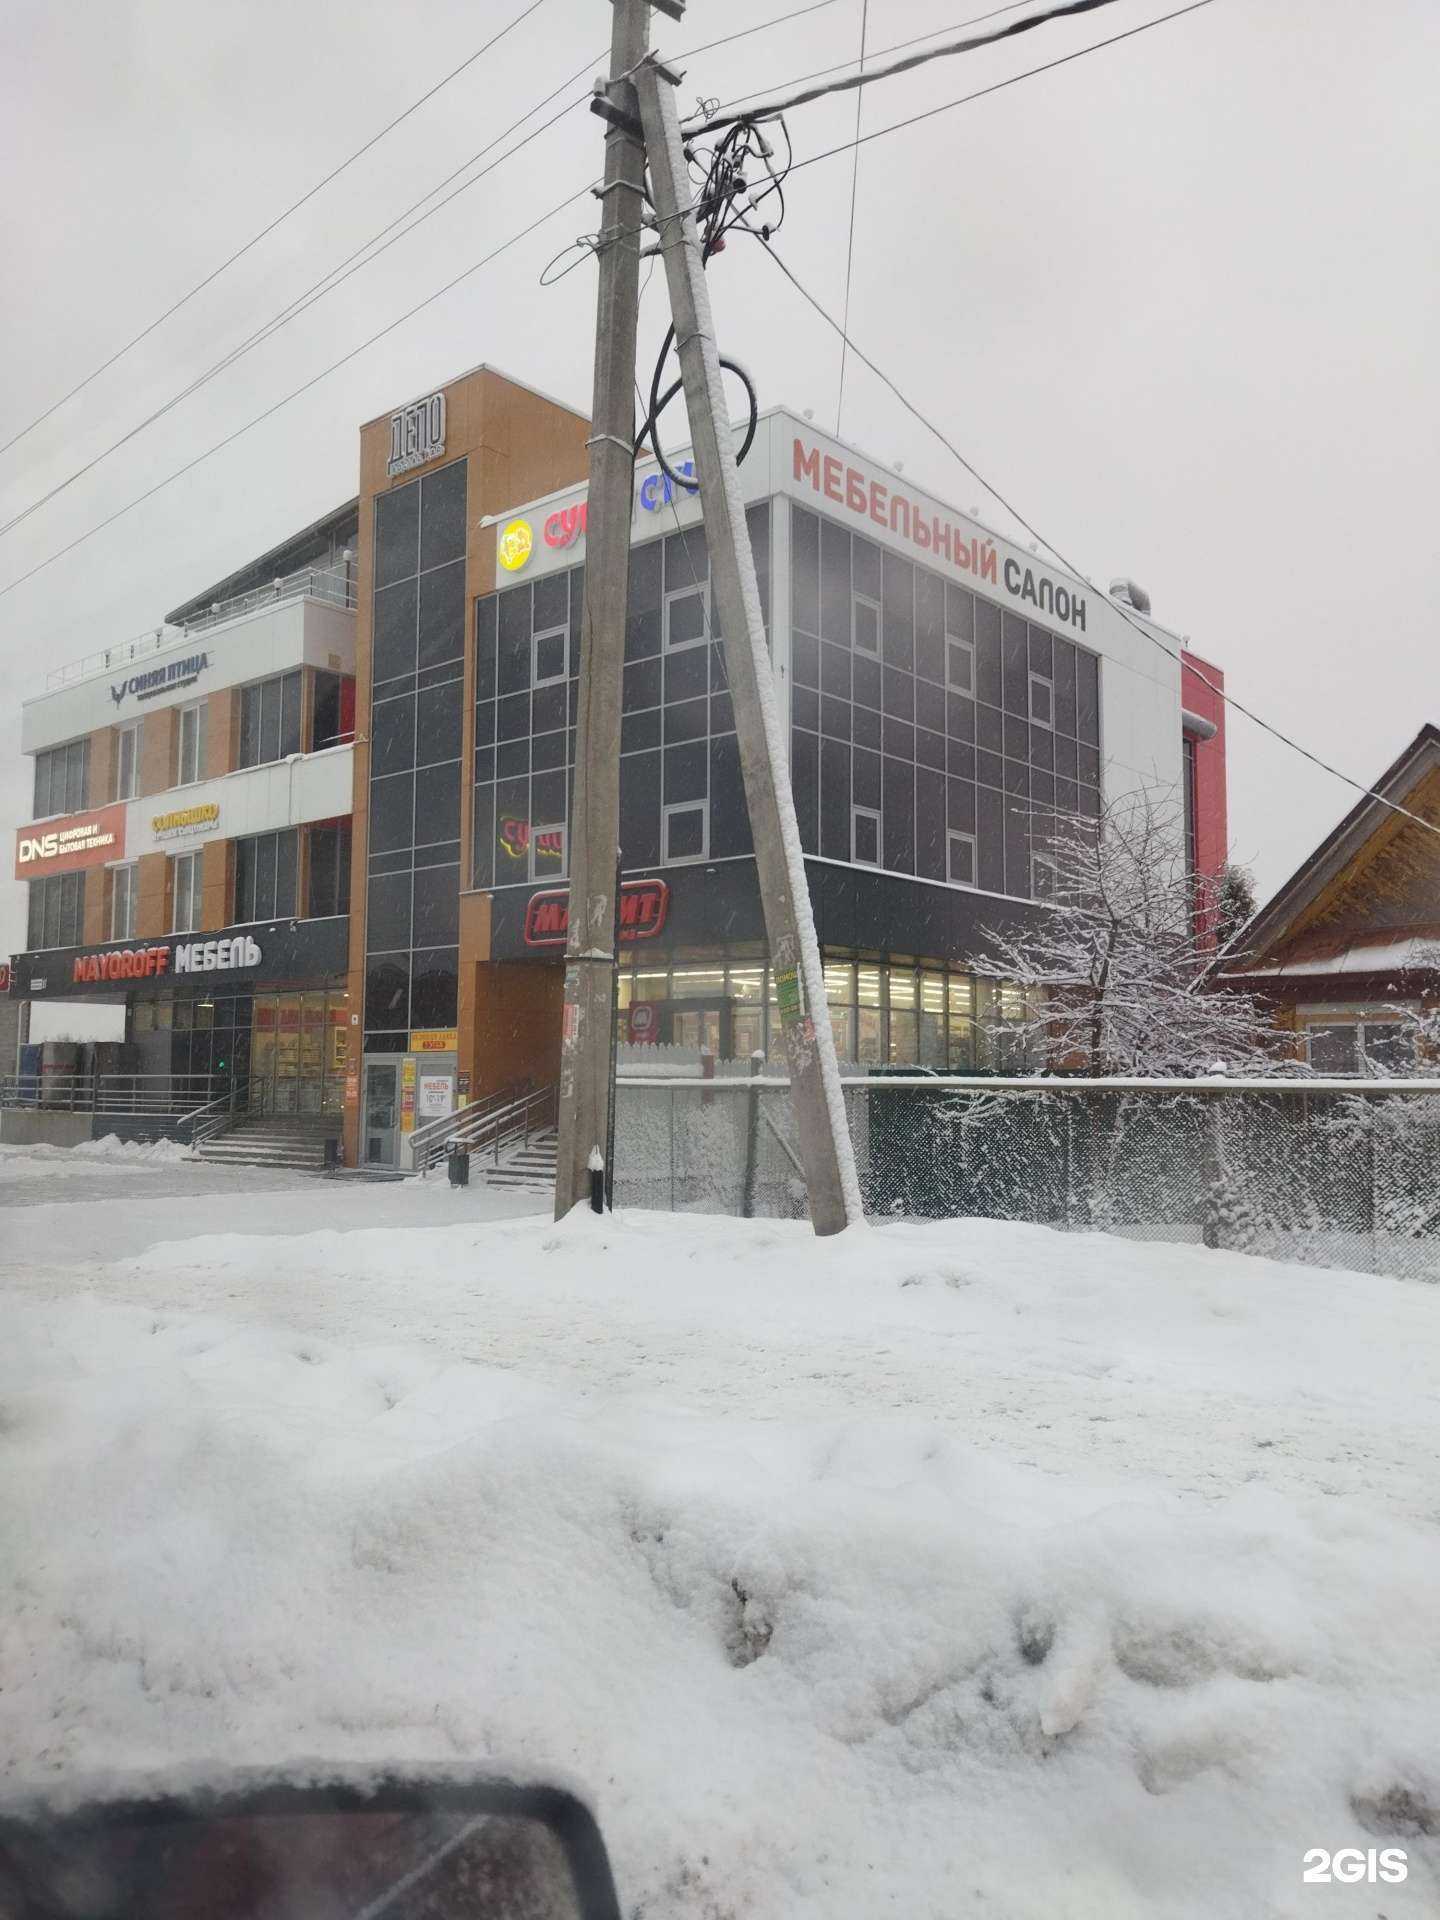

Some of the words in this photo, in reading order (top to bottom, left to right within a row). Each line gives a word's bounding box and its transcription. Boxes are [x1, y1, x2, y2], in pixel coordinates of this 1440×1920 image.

[793, 438, 997, 584] МЕБЕЛЬНЫЙ
[1004, 558, 1086, 631] САЛОН
[19, 833, 58, 863] DNS
[59, 841, 85, 854] БЫТОВАЯ
[86, 833, 113, 848] ТЕХНИКА
[60, 825, 92, 842] ЦИФРОВАЯ
[73, 946, 170, 983] MAYOROFF
[175, 935, 263, 974] МЕБЕЛЬ
